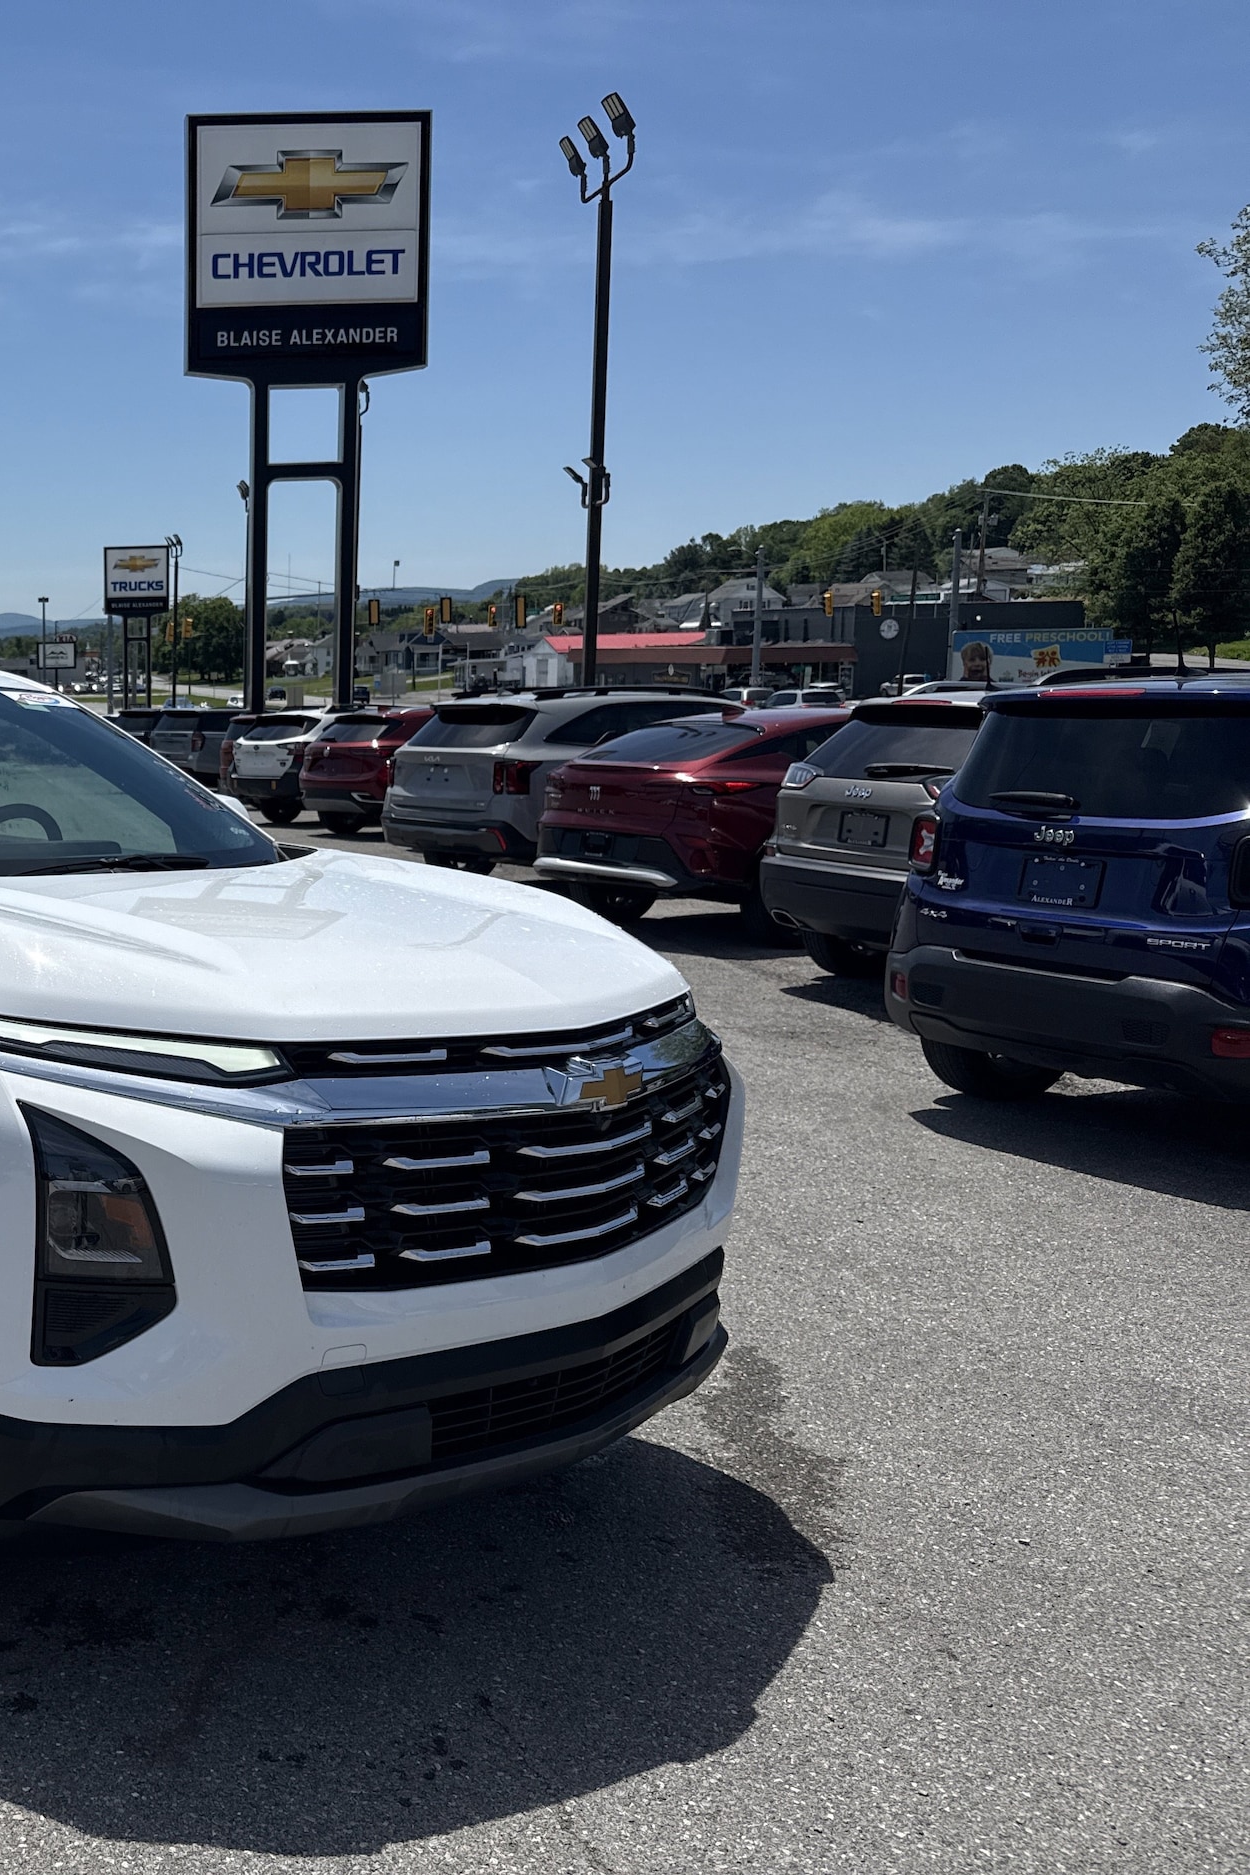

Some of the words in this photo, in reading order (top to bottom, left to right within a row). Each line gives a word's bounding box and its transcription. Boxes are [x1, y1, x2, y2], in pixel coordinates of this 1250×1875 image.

[211, 248, 406, 280] CHEVROLET
[216, 329, 282, 347] BLAISE
[289, 326, 398, 346] ALEXANDER
[110, 580, 164, 592] TRUCKS
[132, 601, 164, 609] ALEXANDER
[989, 632, 1021, 644] FREE
[1025, 630, 1111, 643] PRESCHOOL!
[844, 785, 873, 800] Jeep
[577, 807, 615, 815] BUICK
[1034, 825, 1075, 846] Jeep
[919, 907, 948, 919] 4x4
[1146, 937, 1211, 951] SPORT
